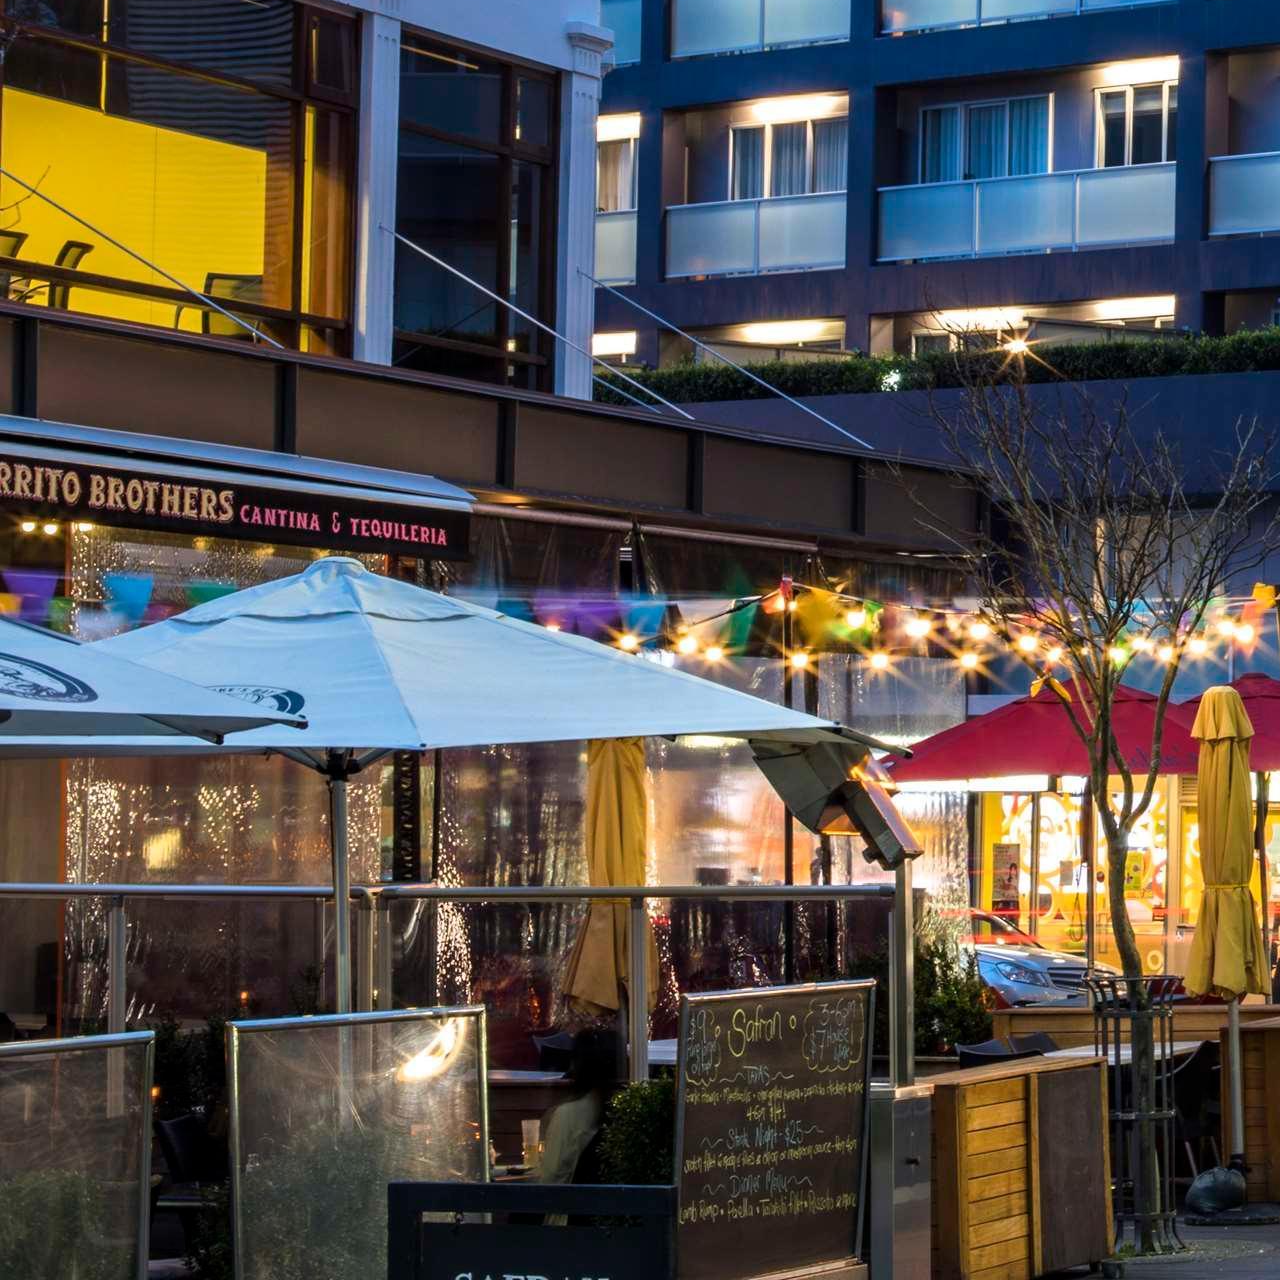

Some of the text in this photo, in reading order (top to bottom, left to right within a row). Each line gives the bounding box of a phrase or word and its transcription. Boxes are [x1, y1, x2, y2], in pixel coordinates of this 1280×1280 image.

[88, 474, 235, 524] BROTHERS
[240, 505, 320, 532] CANTINA
[331, 511, 341, 534] &
[350, 518, 448, 546] TEQUILERIA
[728, 1004, 783, 1057] Safran
